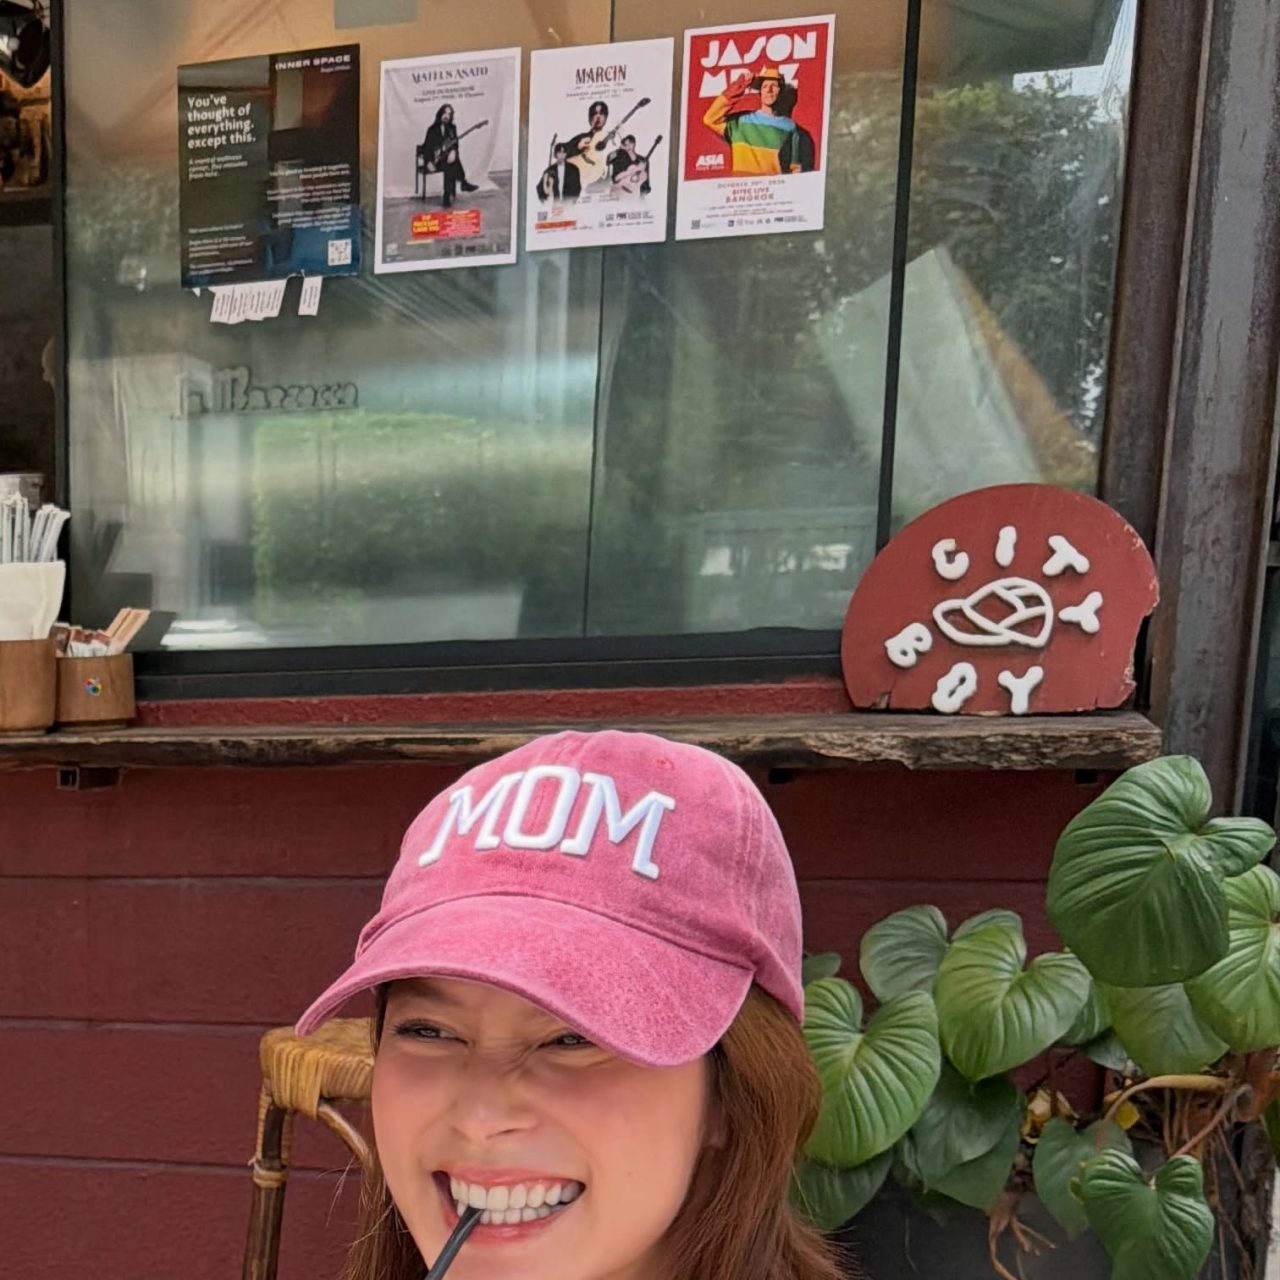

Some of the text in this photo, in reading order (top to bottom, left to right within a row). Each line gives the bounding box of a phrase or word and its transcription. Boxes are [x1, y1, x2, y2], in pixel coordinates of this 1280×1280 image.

[700, 31, 817, 68] JASON
[275, 60, 311, 71] INNER
[313, 54, 352, 66] SPACE
[575, 64, 627, 84] MARCIN
[187, 94, 227, 108] You've
[187, 102, 251, 123] thought of
[187, 134, 227, 149] except
[696, 153, 725, 167] ASIA
[725, 192, 775, 204] BANGKOK
[932, 525, 1104, 634] CITY
[884, 621, 1045, 714] BOY
[417, 764, 676, 880] MOM
